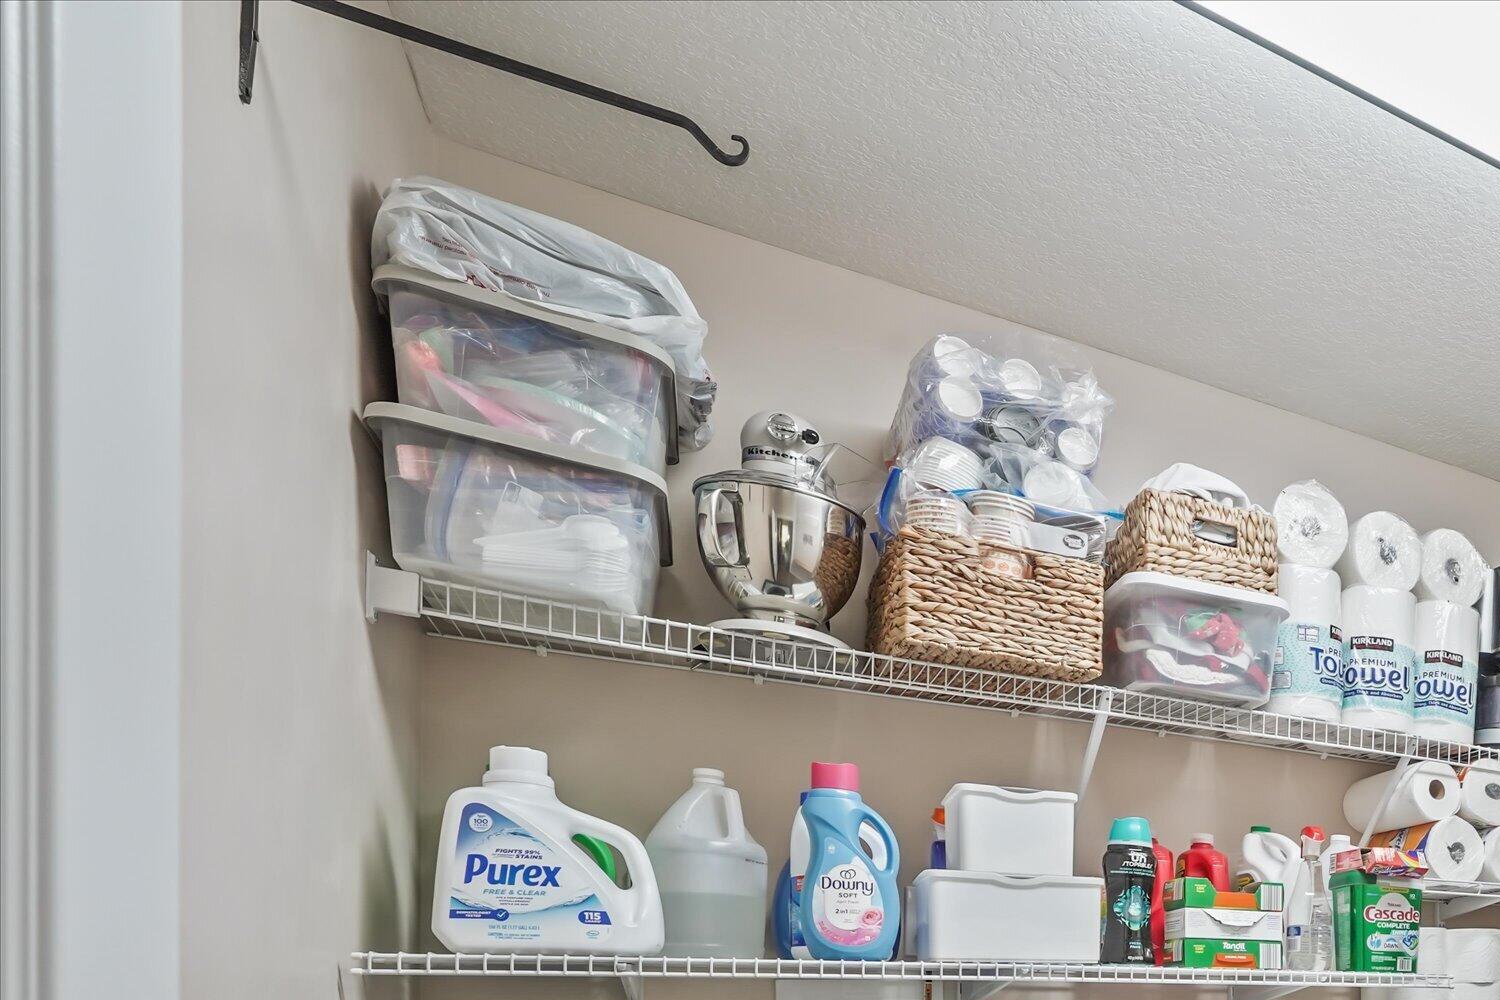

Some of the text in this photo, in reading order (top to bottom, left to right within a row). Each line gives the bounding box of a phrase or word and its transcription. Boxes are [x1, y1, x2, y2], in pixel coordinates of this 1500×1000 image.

[1352, 637, 1393, 647] KIRKLAND
[1426, 651, 1462, 662] KIRKLAND
[1343, 665, 1409, 691] owel
[1414, 676, 1473, 706] owel
[464, 854, 562, 888] Purex
[821, 876, 874, 896] Downy
[583, 912, 601, 920] 115
[1365, 906, 1420, 922] Cascade
[1377, 922, 1411, 930] COMPLETE
